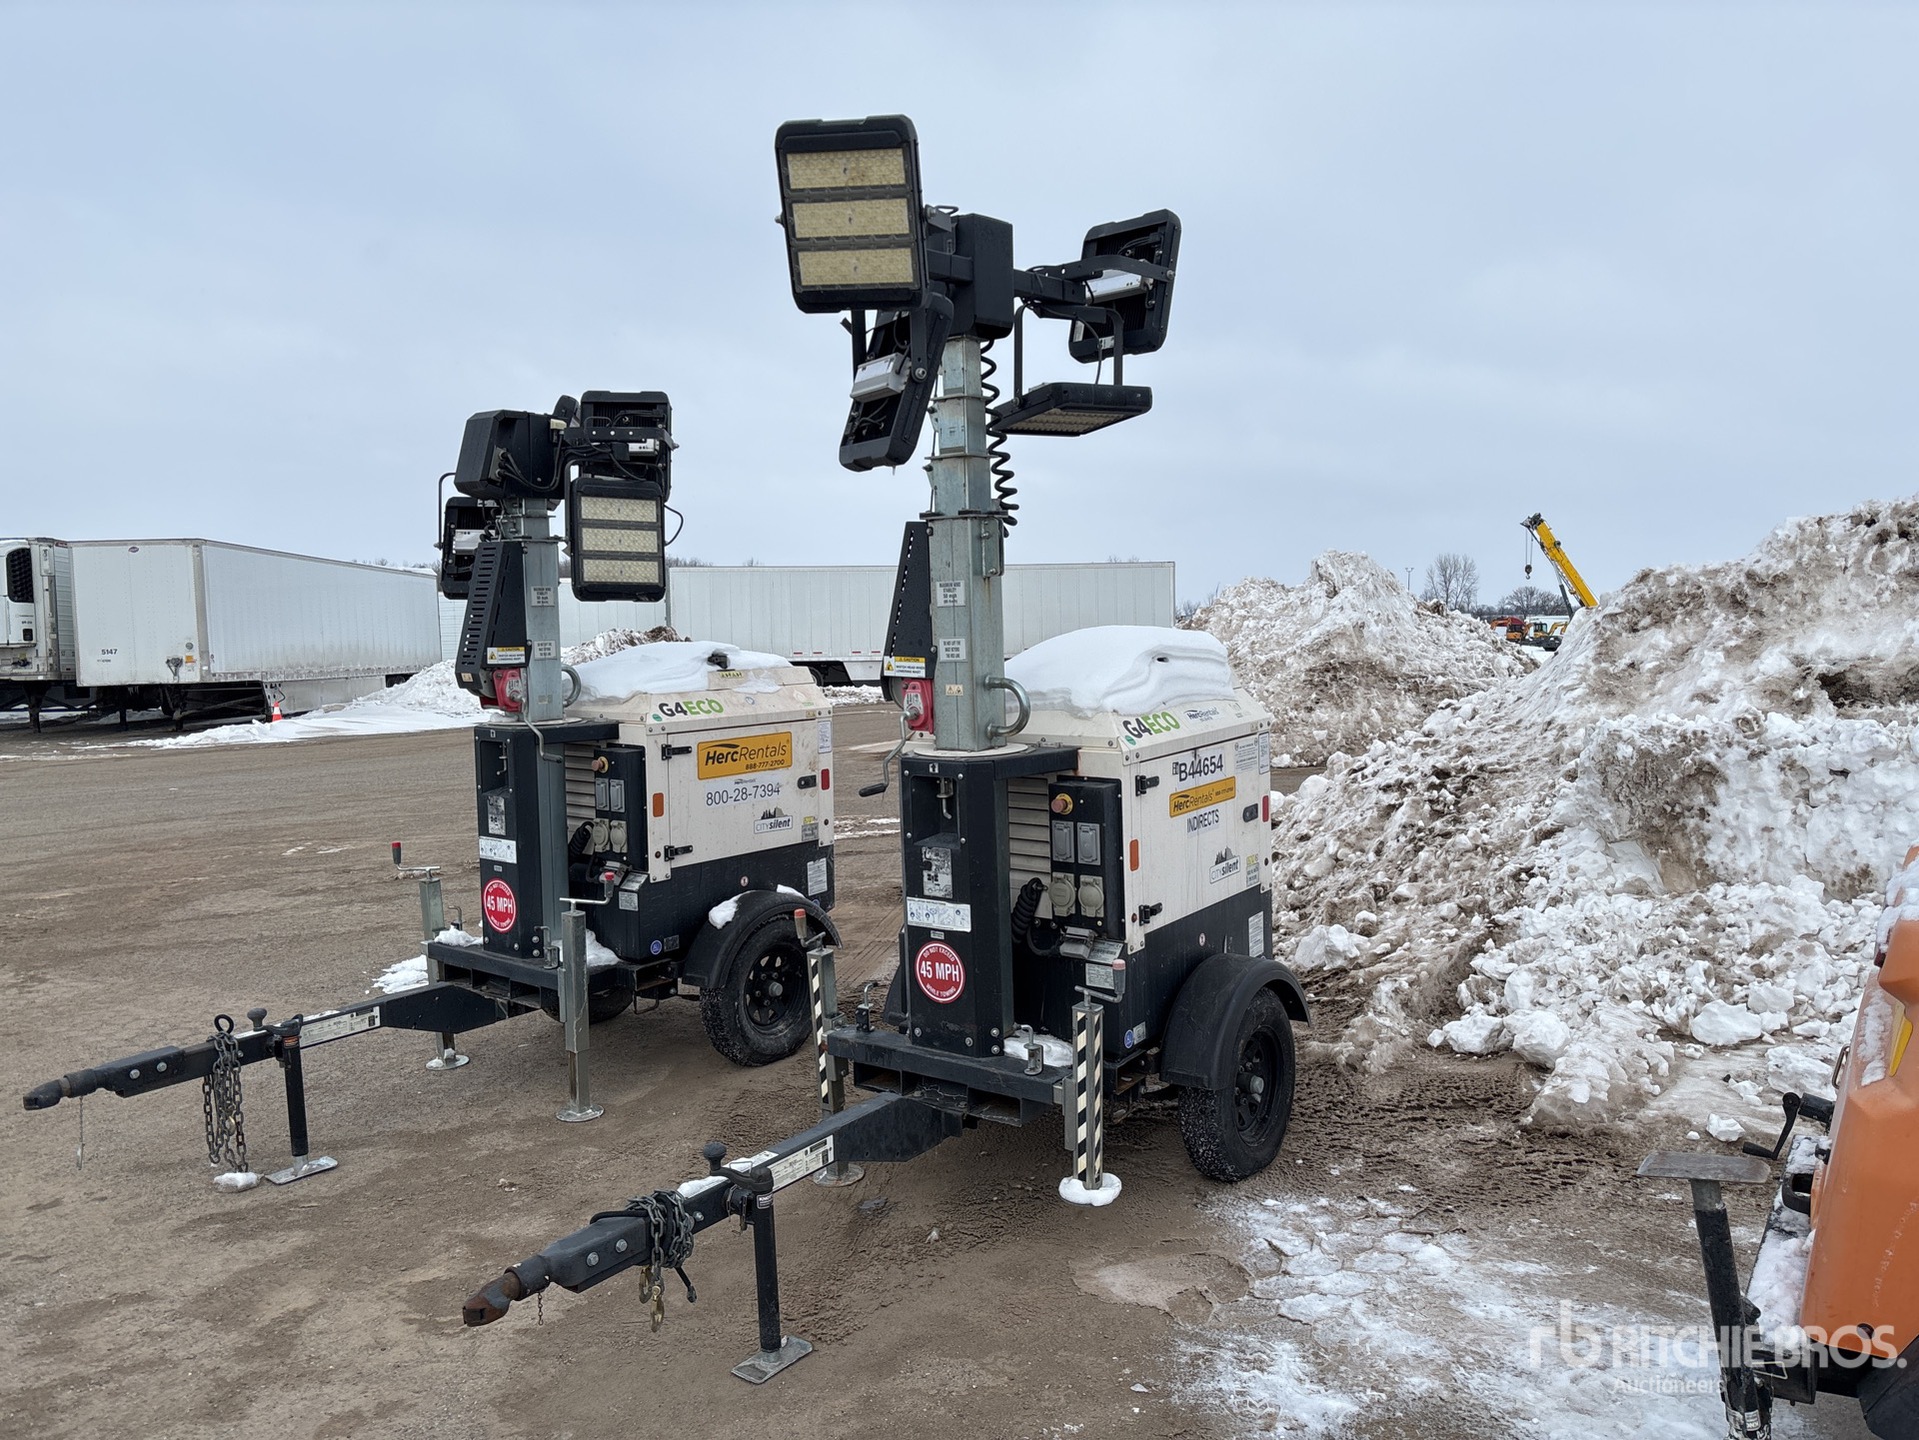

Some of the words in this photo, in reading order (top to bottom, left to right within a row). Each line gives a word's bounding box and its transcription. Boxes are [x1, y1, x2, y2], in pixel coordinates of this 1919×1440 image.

[658, 698, 724, 717] G4ECO
[1122, 711, 1181, 739] G4ECO
[704, 742, 787, 766] HercRentals
[745, 759, 785, 770] 888-777-2700
[1179, 754, 1224, 782] B44654
[706, 782, 781, 806] 800-28-7394
[1186, 808, 1220, 833] INDIRECTS
[486, 895, 496, 911] 45
[496, 896, 513, 914] MPH
[923, 950, 930, 958] DO
[939, 947, 955, 962] EXCEED
[920, 960, 933, 979] 45
[935, 962, 960, 982] MPH
